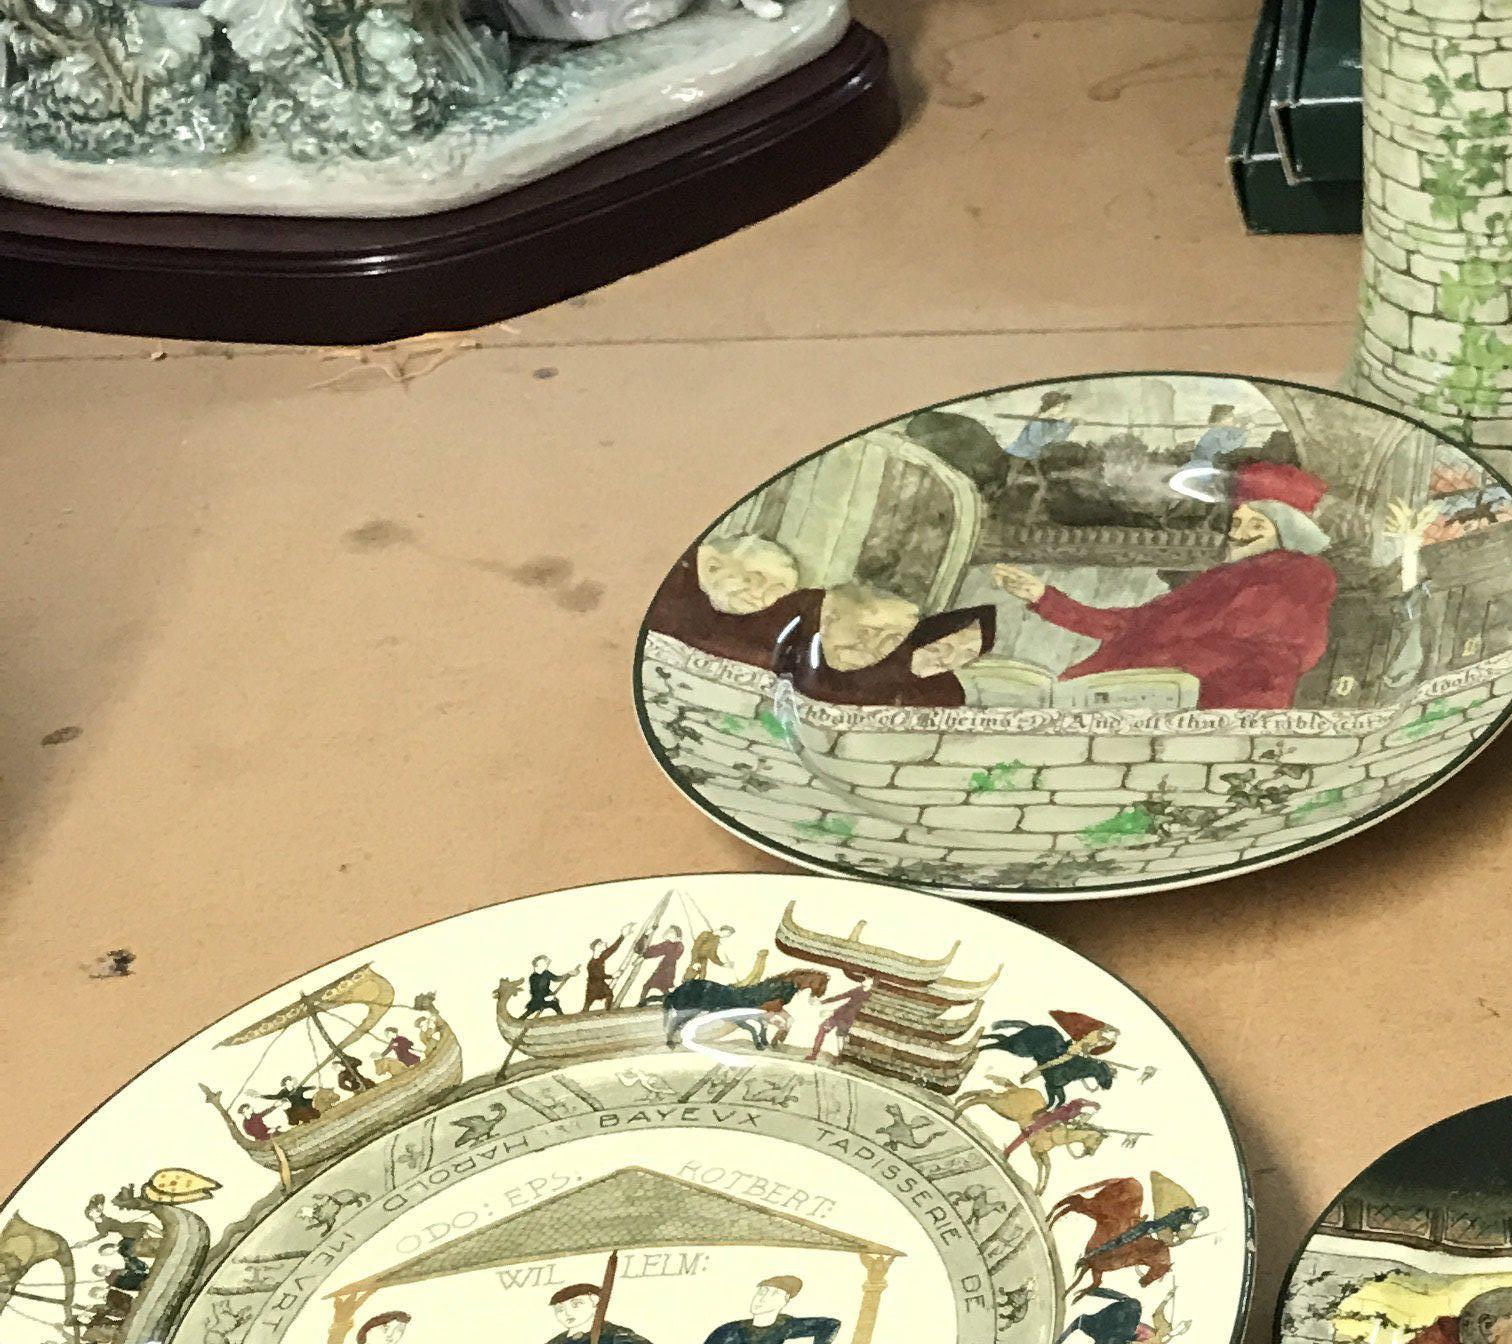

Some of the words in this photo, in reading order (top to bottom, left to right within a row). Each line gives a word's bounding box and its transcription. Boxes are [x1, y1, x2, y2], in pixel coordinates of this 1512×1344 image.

[383, 1135, 529, 1212] HAROLD
[815, 1127, 962, 1246] TAPISSERIE
[961, 1274, 987, 1313] DE
